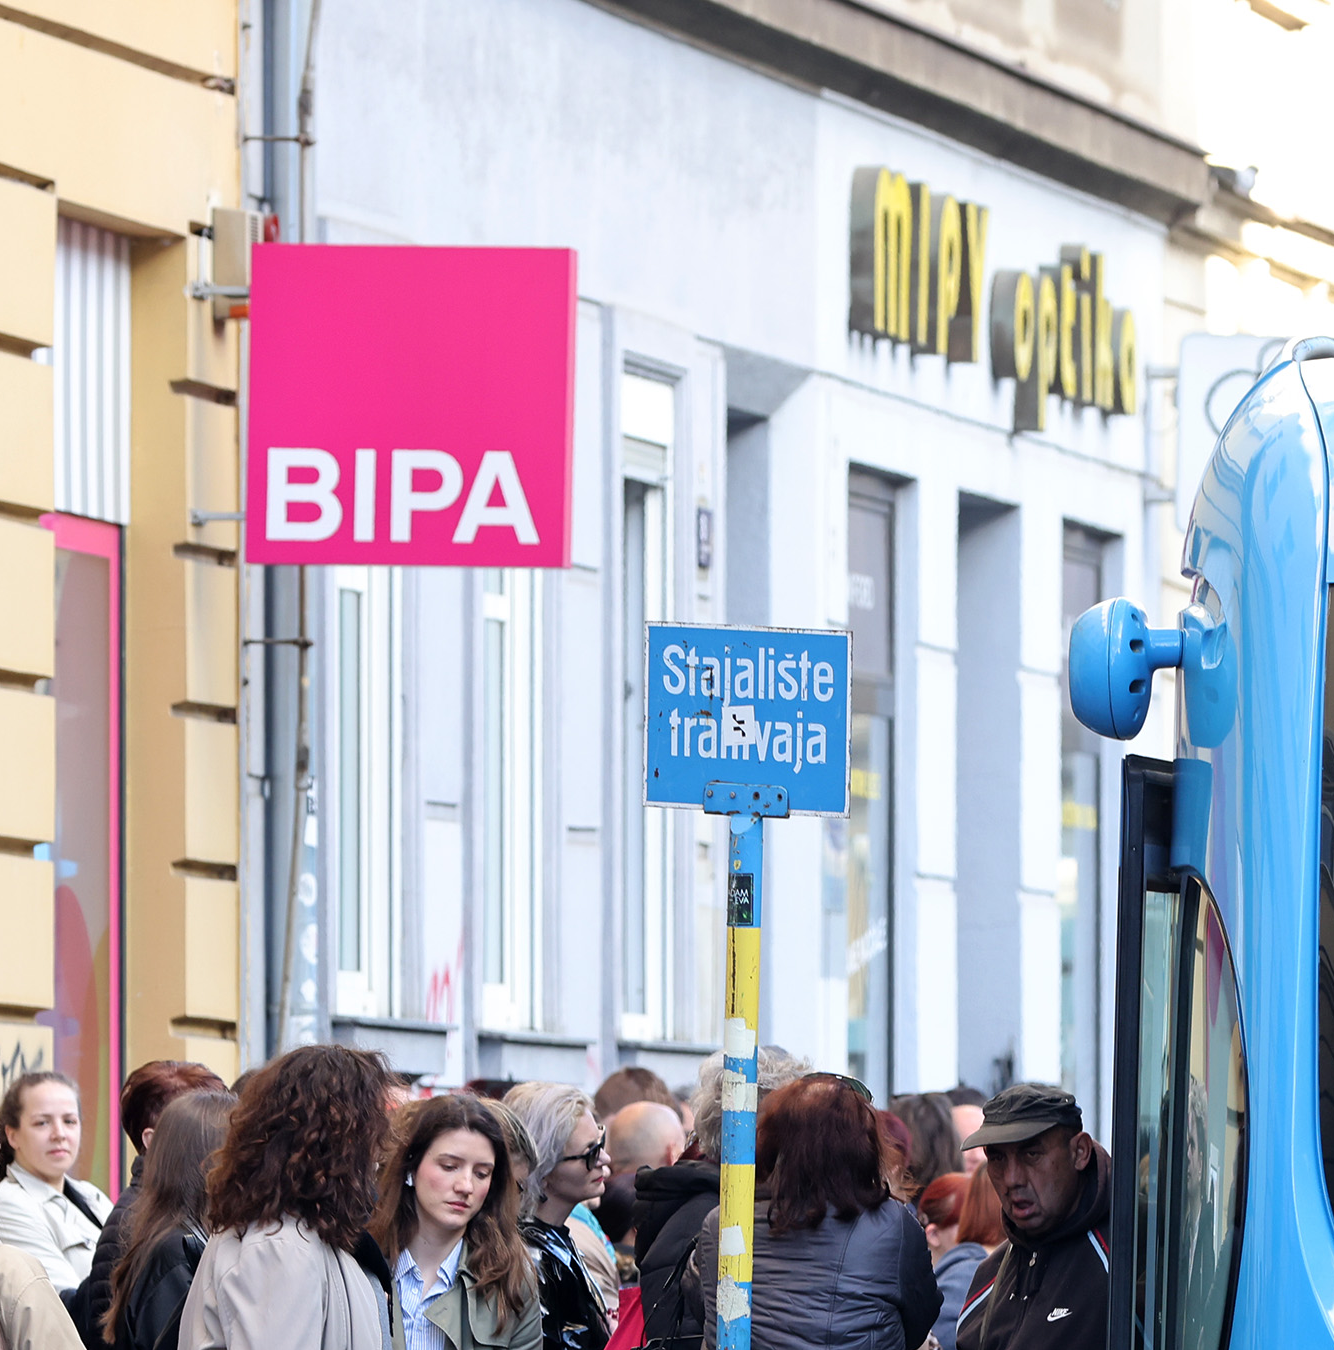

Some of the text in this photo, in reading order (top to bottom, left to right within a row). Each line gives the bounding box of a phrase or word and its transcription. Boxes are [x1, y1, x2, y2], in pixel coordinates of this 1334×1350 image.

[1010, 245, 1136, 432] optika
[266, 447, 541, 545] BIPA
[662, 644, 835, 708] Stajalište
